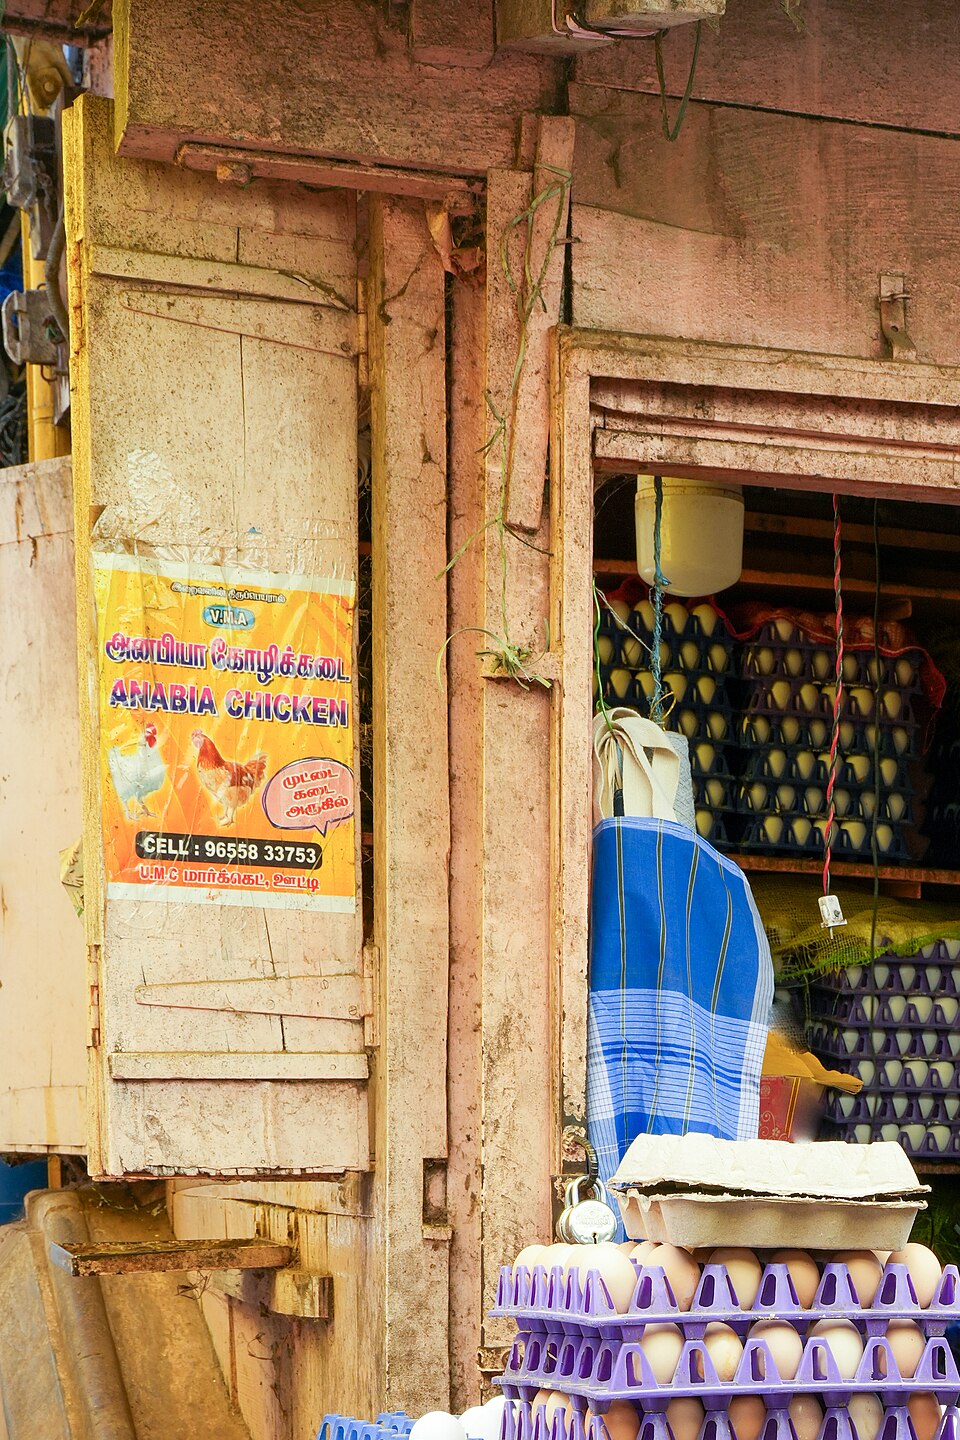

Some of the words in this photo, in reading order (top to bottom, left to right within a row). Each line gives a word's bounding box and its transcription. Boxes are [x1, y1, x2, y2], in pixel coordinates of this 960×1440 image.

[209, 608, 248, 626] V.M.A
[210, 636, 350, 685] கோழிக்கடை
[110, 678, 217, 717] ANABIA
[224, 688, 348, 728] CHICKEN
[282, 767, 339, 791] முட்டை
[293, 784, 335, 801] கடை
[285, 796, 349, 818] அருகில்
[143, 836, 189, 856] CELL
[205, 842, 258, 860] 96558
[264, 845, 317, 864] 33753
